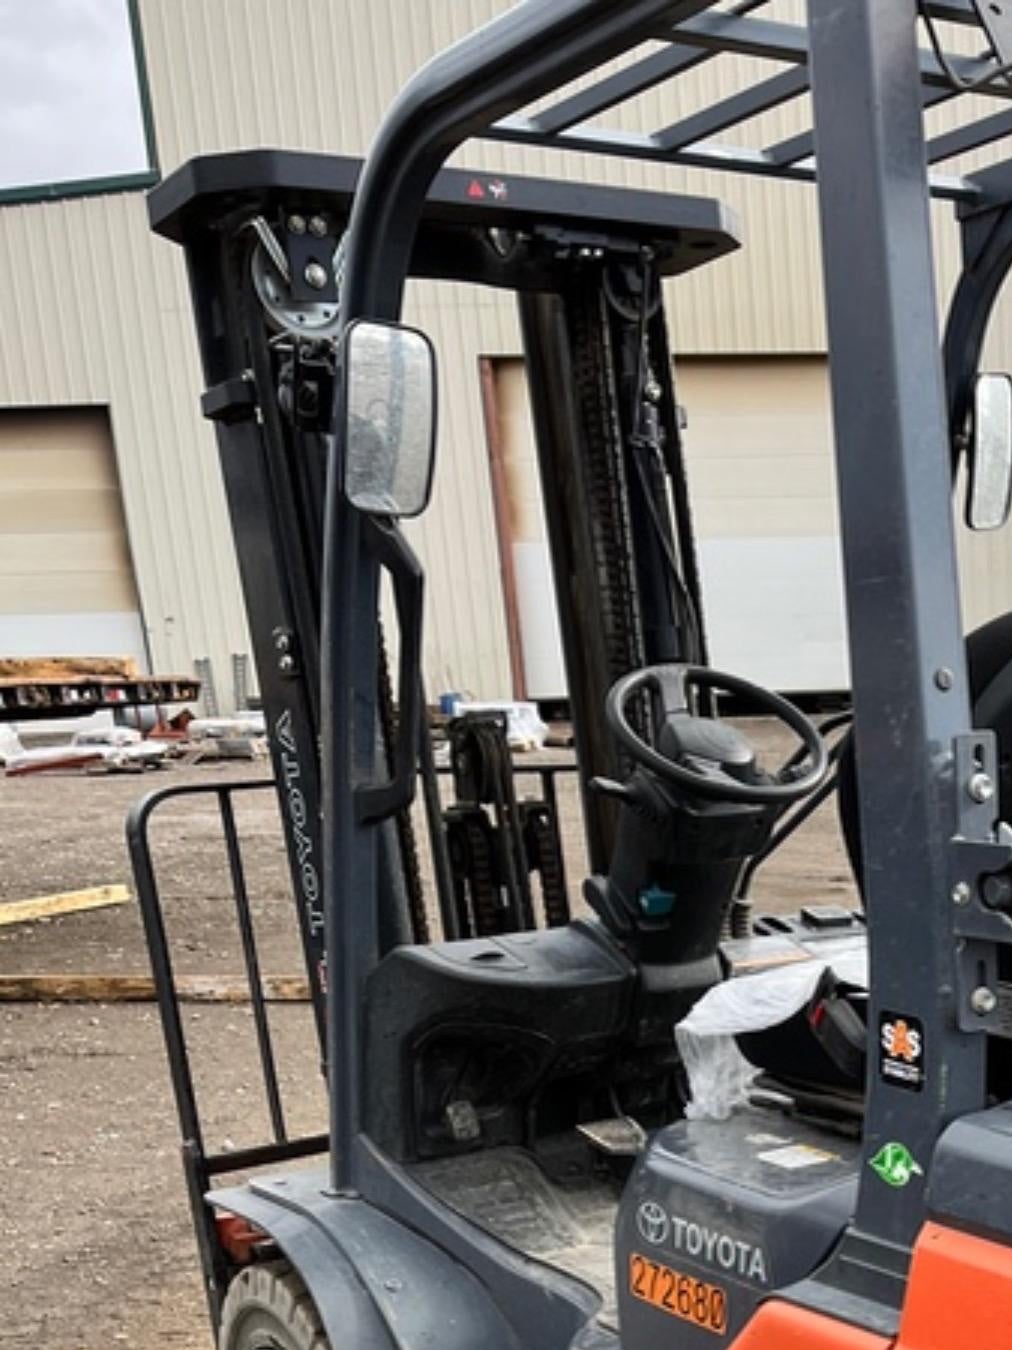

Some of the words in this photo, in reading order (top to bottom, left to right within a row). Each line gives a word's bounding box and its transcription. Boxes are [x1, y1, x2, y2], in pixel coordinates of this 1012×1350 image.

[276, 710, 325, 936] TOYOTA
[671, 1216, 768, 1283] TOYOTA
[631, 1255, 724, 1329] 272680
